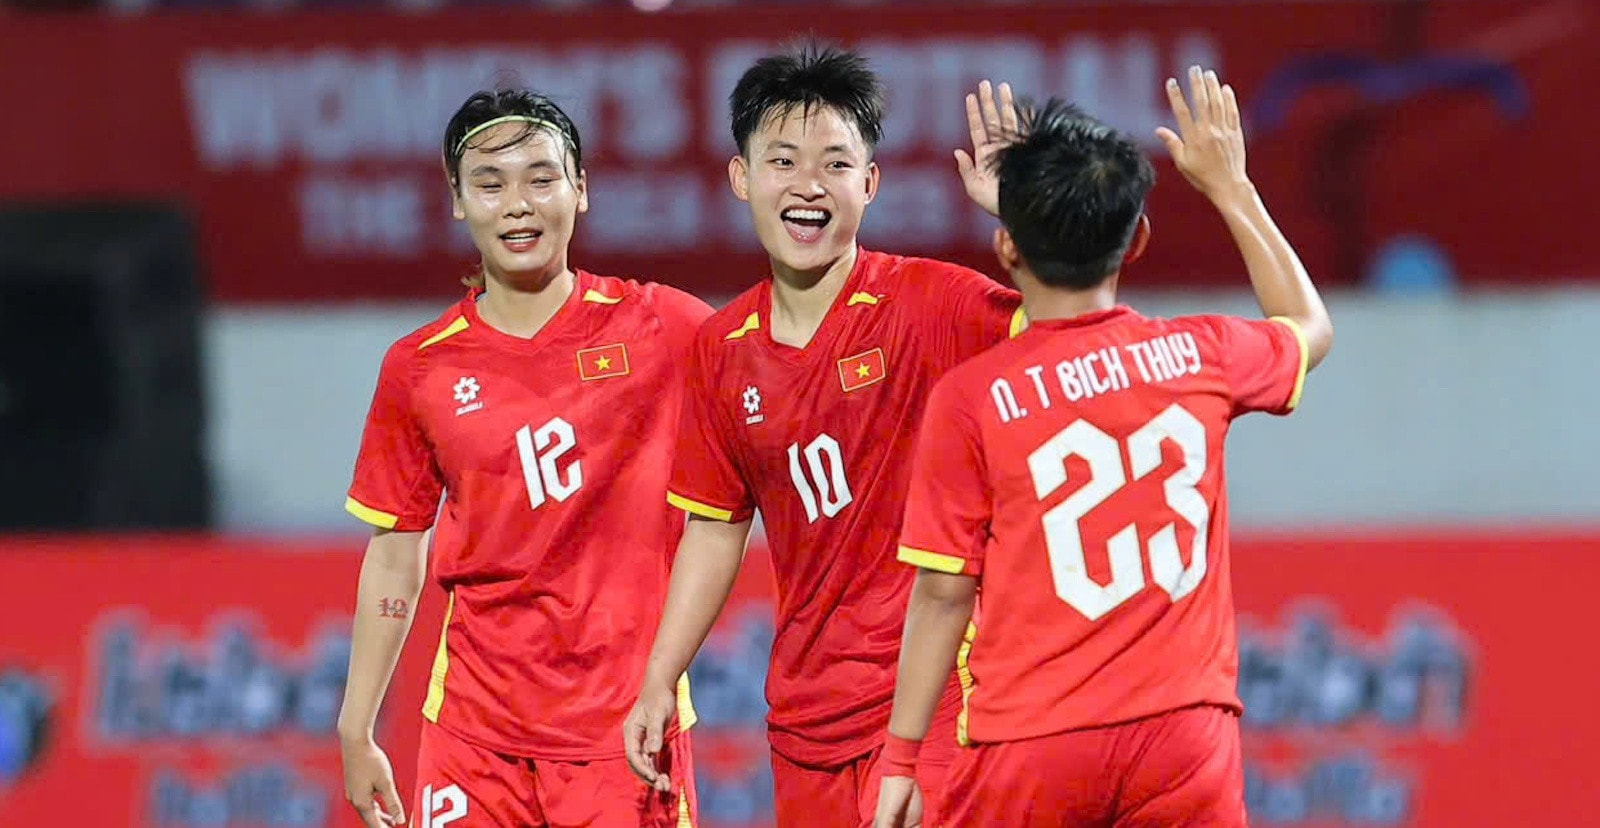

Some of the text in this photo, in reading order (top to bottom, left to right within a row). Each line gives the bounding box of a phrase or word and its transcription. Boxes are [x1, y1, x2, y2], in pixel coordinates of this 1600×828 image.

[1025, 365, 1051, 410] T
[1055, 346, 1131, 402] BICH
[1125, 331, 1202, 384] THUY
[515, 416, 583, 511] 12
[787, 432, 854, 525] 10
[1026, 402, 1210, 622] 23
[377, 597, 408, 619] 12
[421, 782, 469, 828] 12
